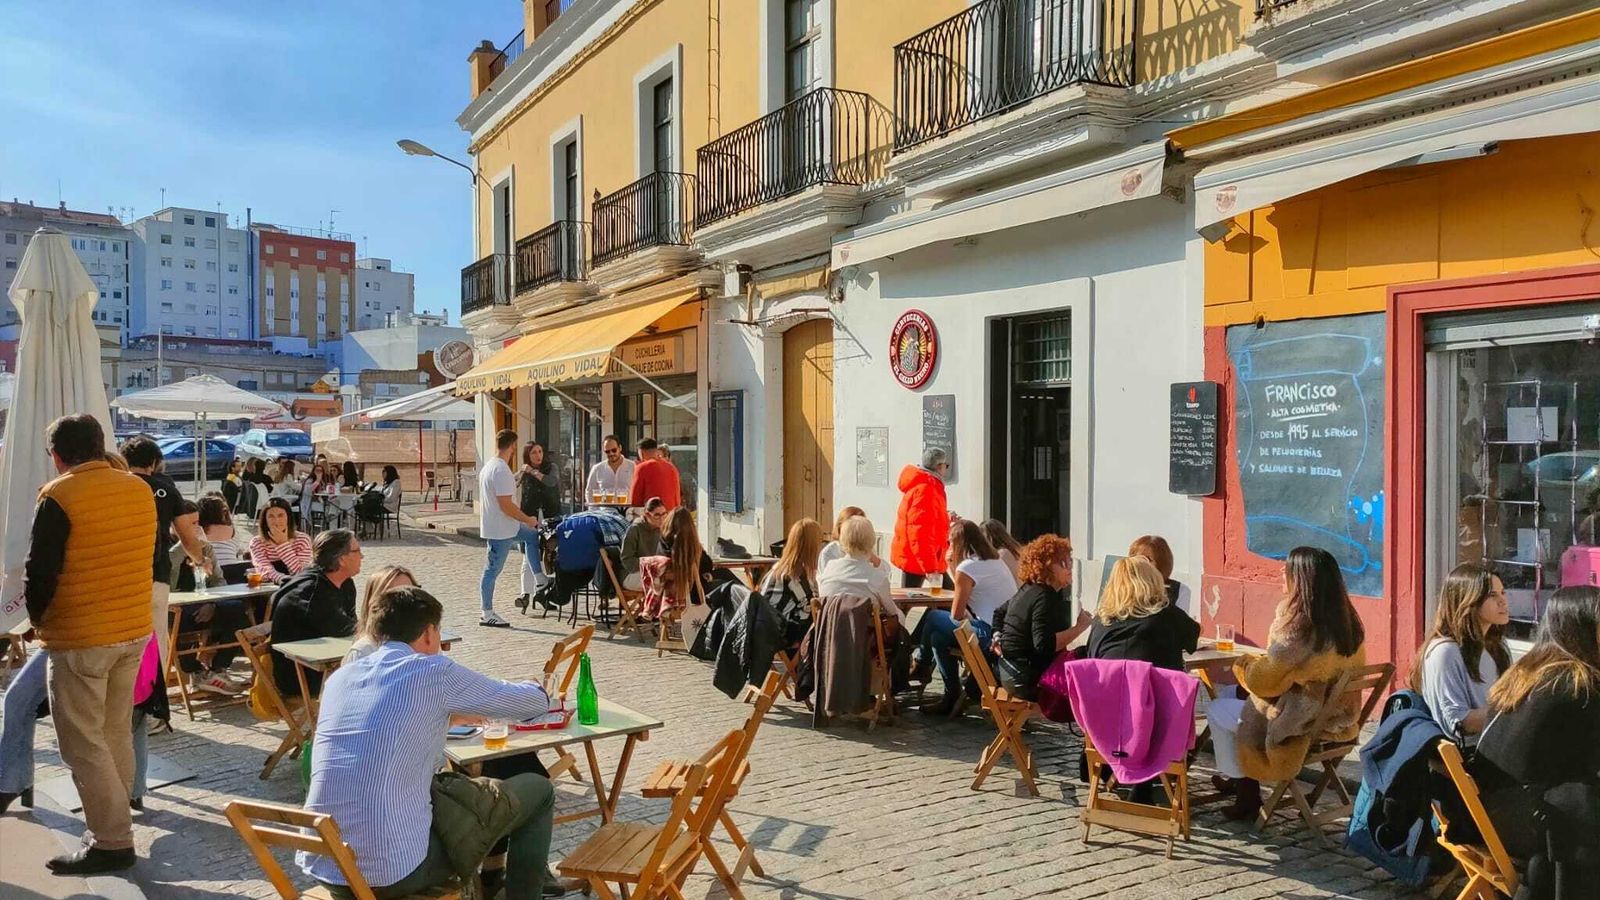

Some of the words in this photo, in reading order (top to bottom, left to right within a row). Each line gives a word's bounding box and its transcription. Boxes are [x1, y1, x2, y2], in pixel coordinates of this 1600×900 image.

[459, 377, 487, 390] AQUILINO
[492, 373, 513, 386] VIDAL
[527, 364, 566, 380] AQUILINO
[574, 357, 603, 373] VIDAL
[1260, 430, 1284, 440] DESDE
[1288, 423, 1309, 442] 1995
[1325, 426, 1358, 438] SERVICIO
[1259, 447, 1270, 457] DE
[1258, 464, 1294, 474] SALONES
[1297, 467, 1307, 475] DE
[1310, 467, 1343, 478] BELLEZA
